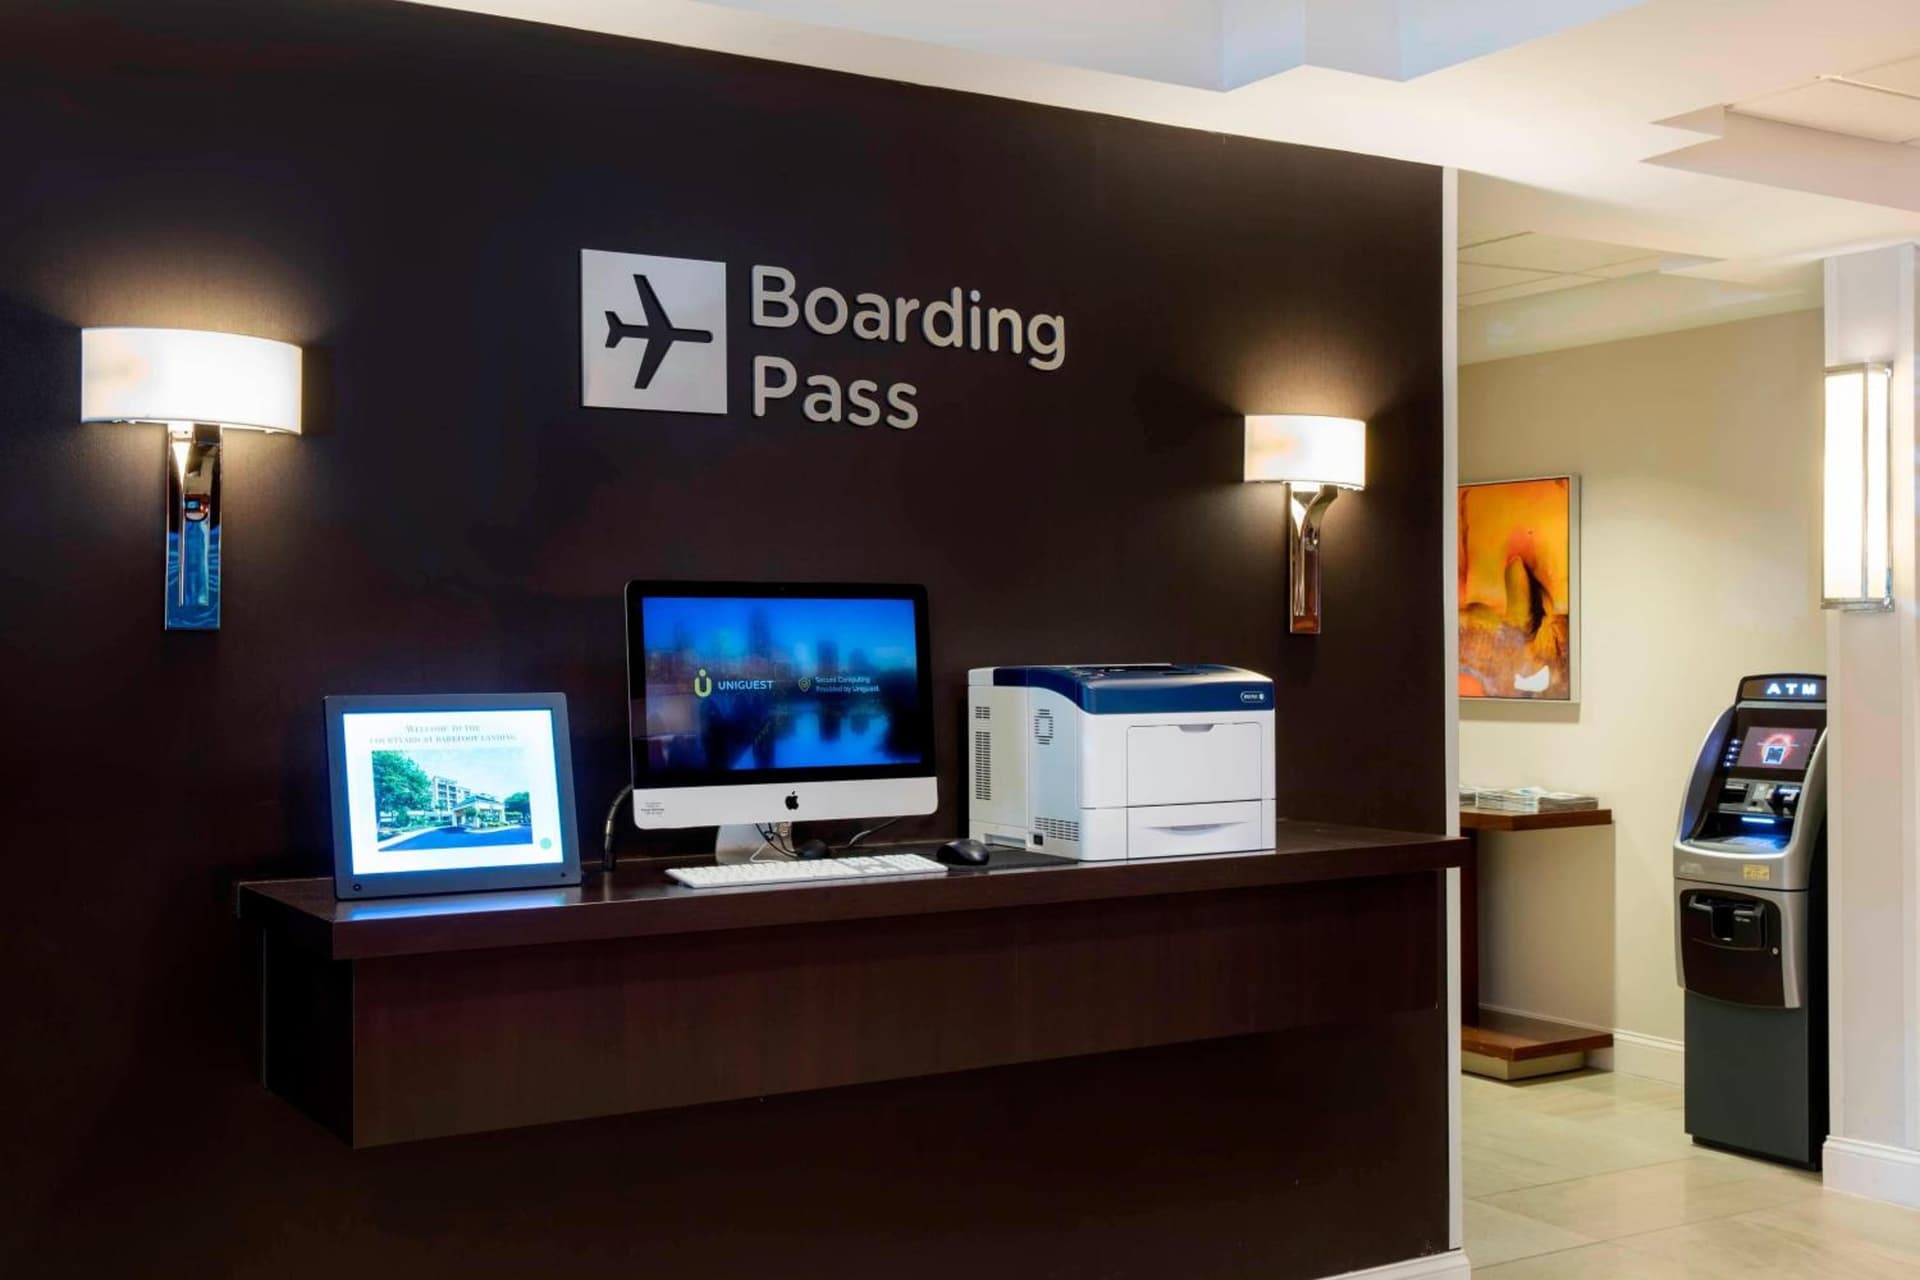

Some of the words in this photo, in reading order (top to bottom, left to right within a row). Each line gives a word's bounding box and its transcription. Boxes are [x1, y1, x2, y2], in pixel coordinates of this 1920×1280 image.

[752, 264, 1067, 371] Boarding
[753, 355, 919, 429] Pass
[717, 680, 775, 690] UNIGUEST
[1766, 683, 1817, 695] ATM
